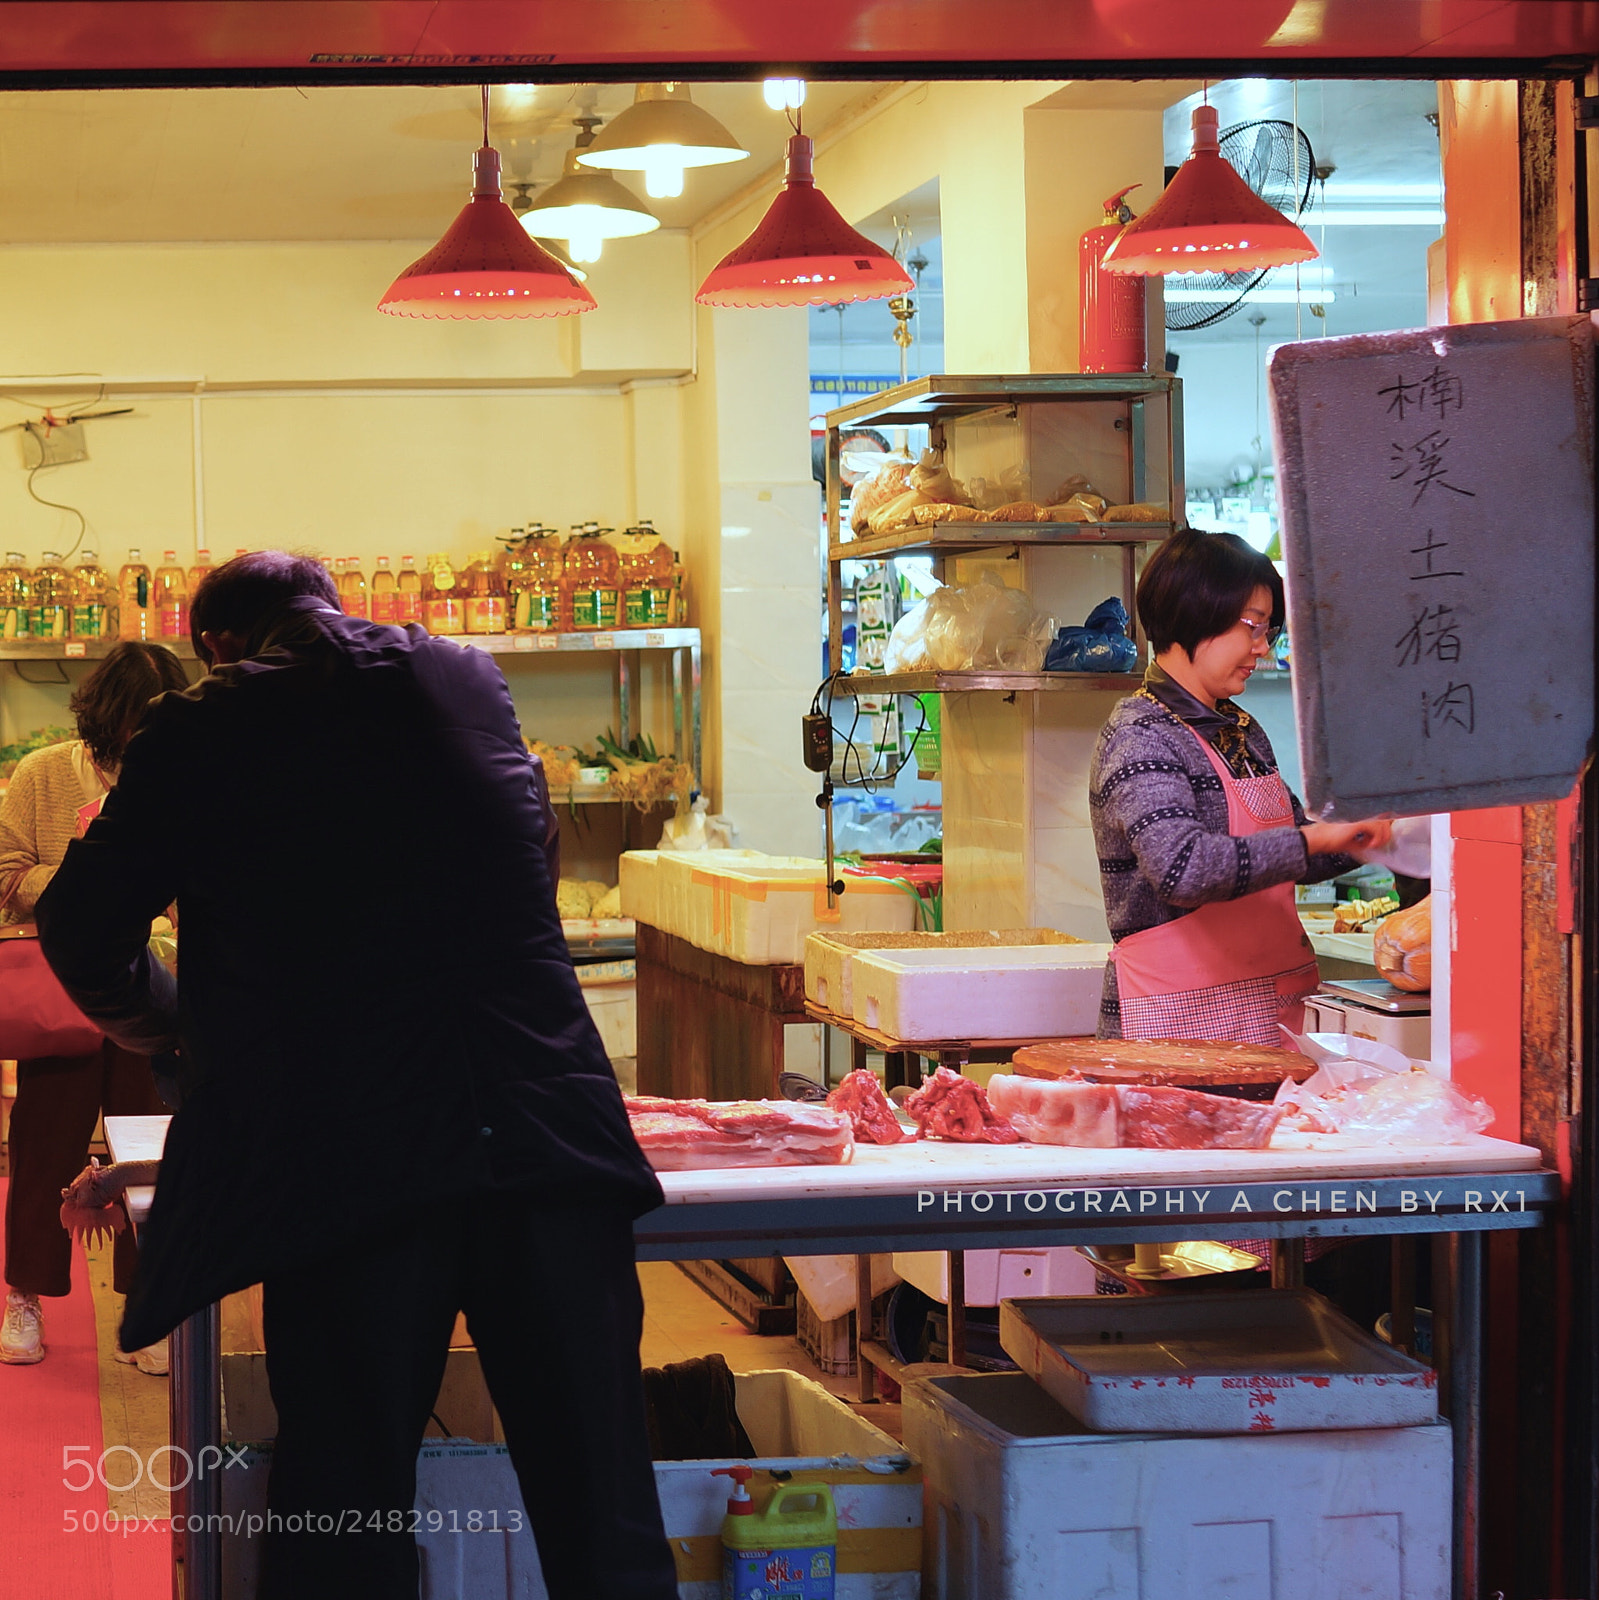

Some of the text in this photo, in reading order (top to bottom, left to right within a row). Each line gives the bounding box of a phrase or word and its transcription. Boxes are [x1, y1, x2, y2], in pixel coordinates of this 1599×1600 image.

[1376, 365, 1476, 739] 楠溪土猪肉
